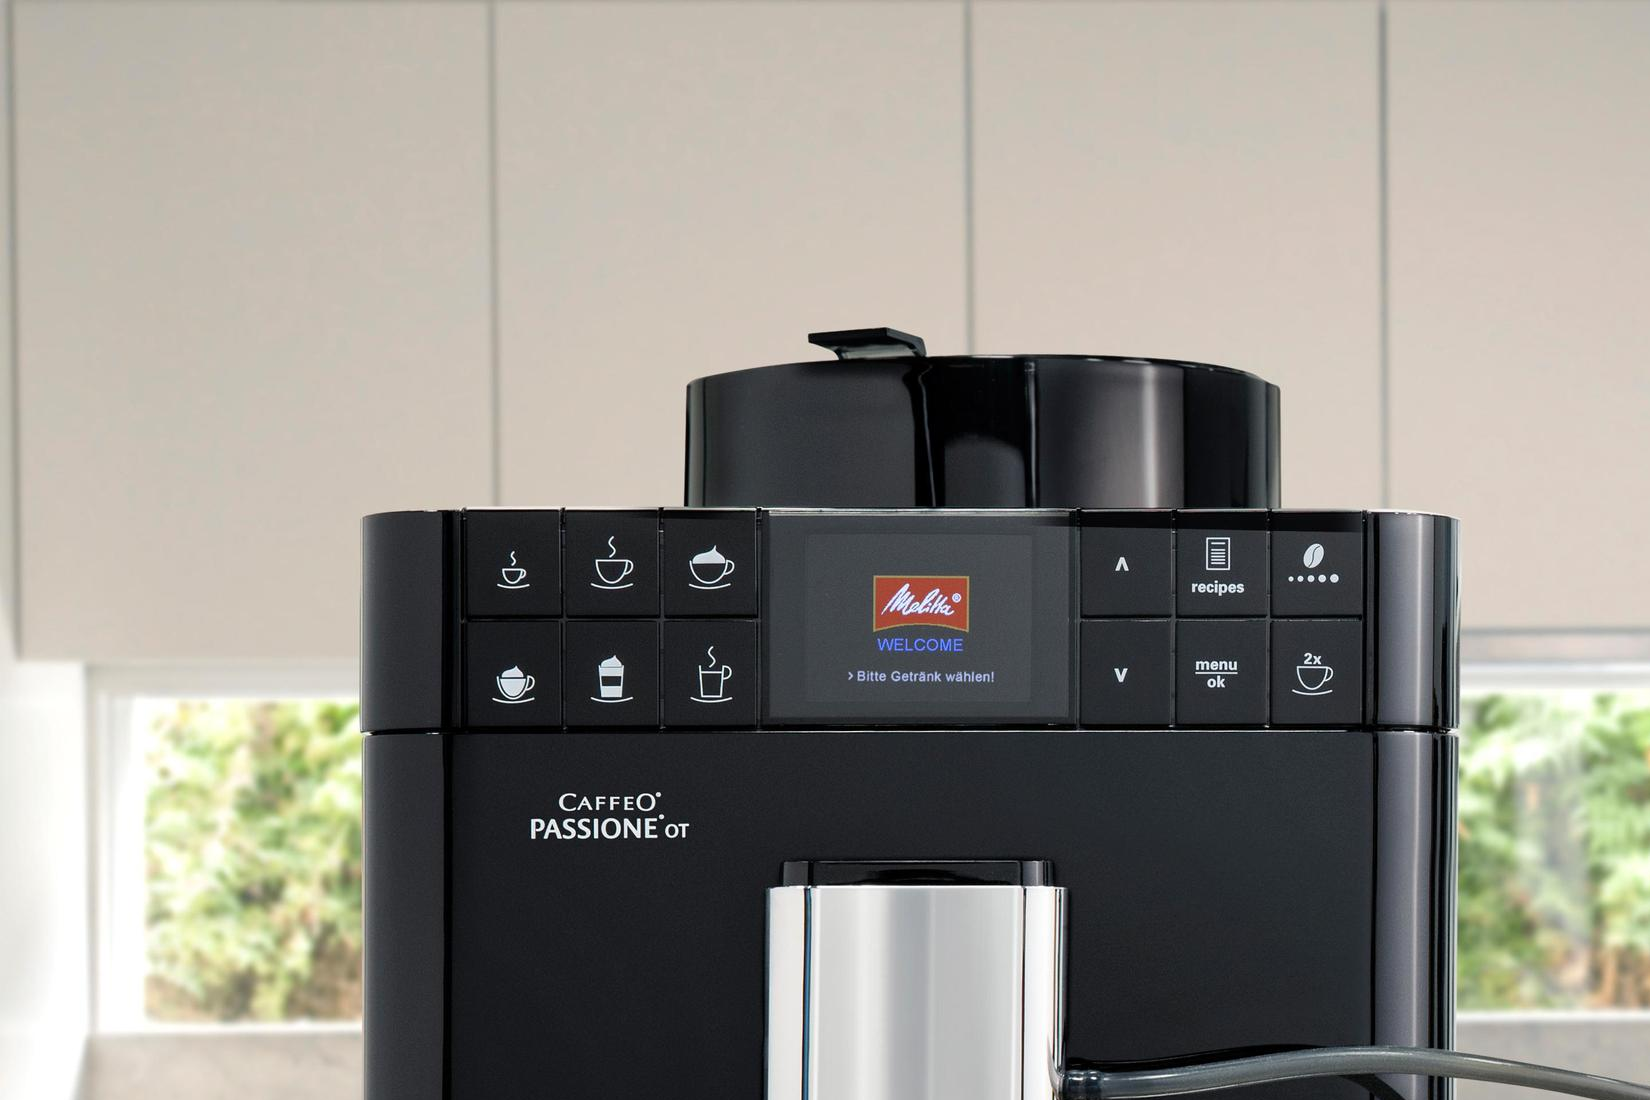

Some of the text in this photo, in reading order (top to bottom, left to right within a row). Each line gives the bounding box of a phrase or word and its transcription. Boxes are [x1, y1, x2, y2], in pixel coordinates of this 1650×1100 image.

[1191, 579, 1245, 596] recipes
[880, 583, 955, 616] Melitta
[876, 637, 965, 652] WELCOME
[1195, 660, 1238, 671] menu
[1303, 652, 1322, 665] 2x
[857, 670, 995, 682] Bitte Getränk wählen!
[1206, 674, 1226, 689] ok
[530, 817, 690, 840] PASSIONE OT
